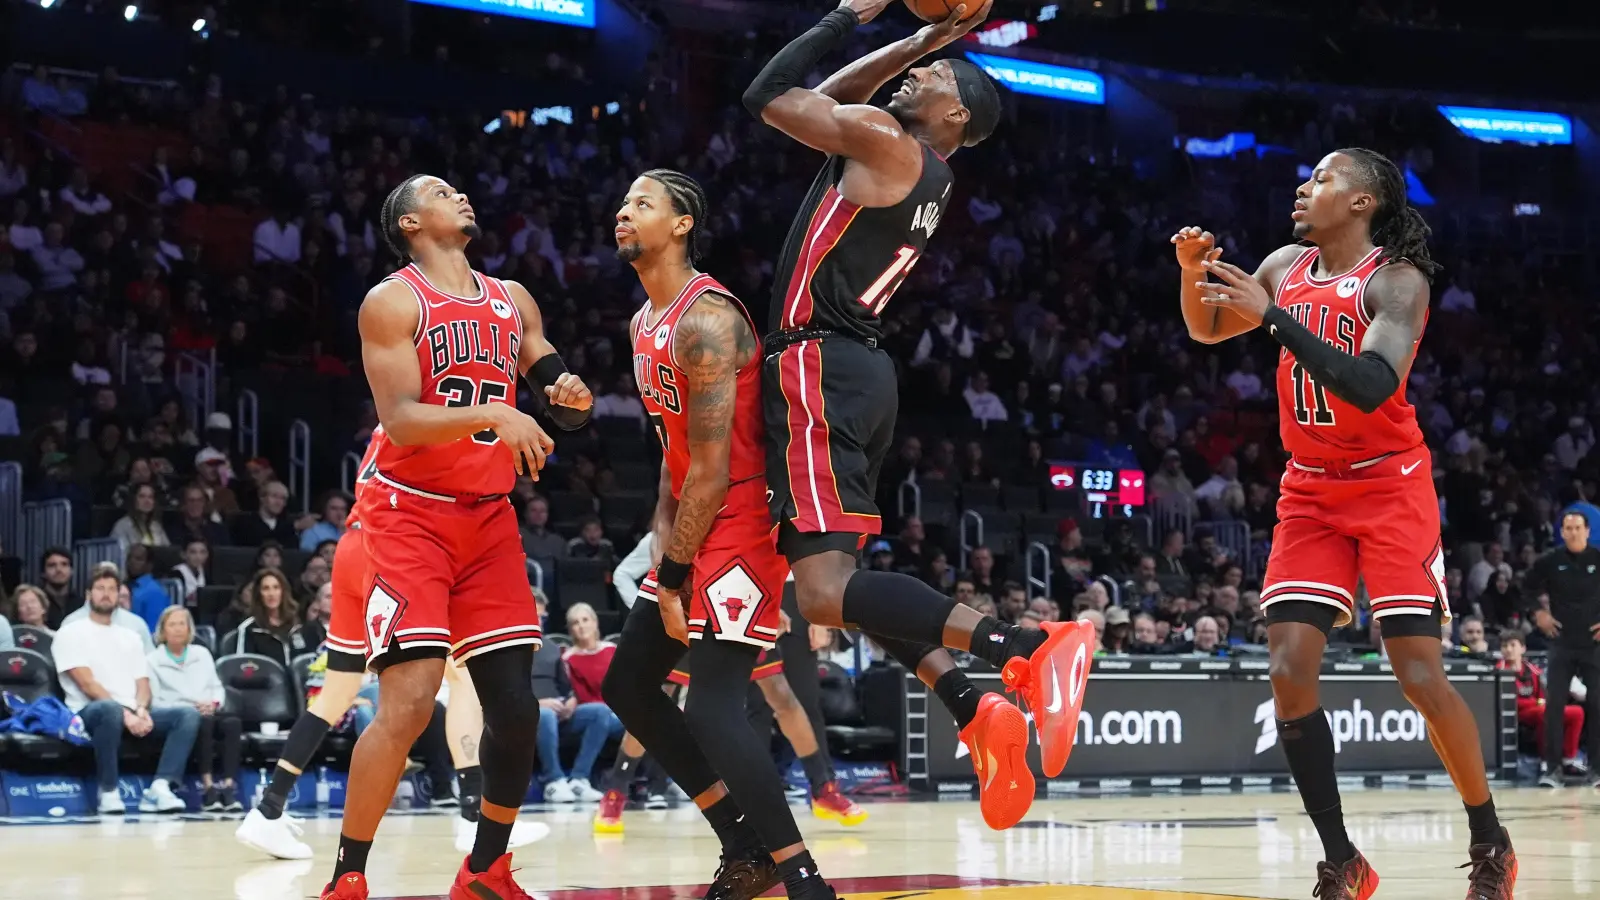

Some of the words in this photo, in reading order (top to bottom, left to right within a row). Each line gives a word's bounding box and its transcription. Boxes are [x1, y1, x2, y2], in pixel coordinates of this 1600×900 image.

[427, 320, 519, 383] BULLS
[1291, 361, 1336, 426] 11
[1082, 469, 1114, 490] 6:33
[1323, 698, 1426, 754] ph.co
